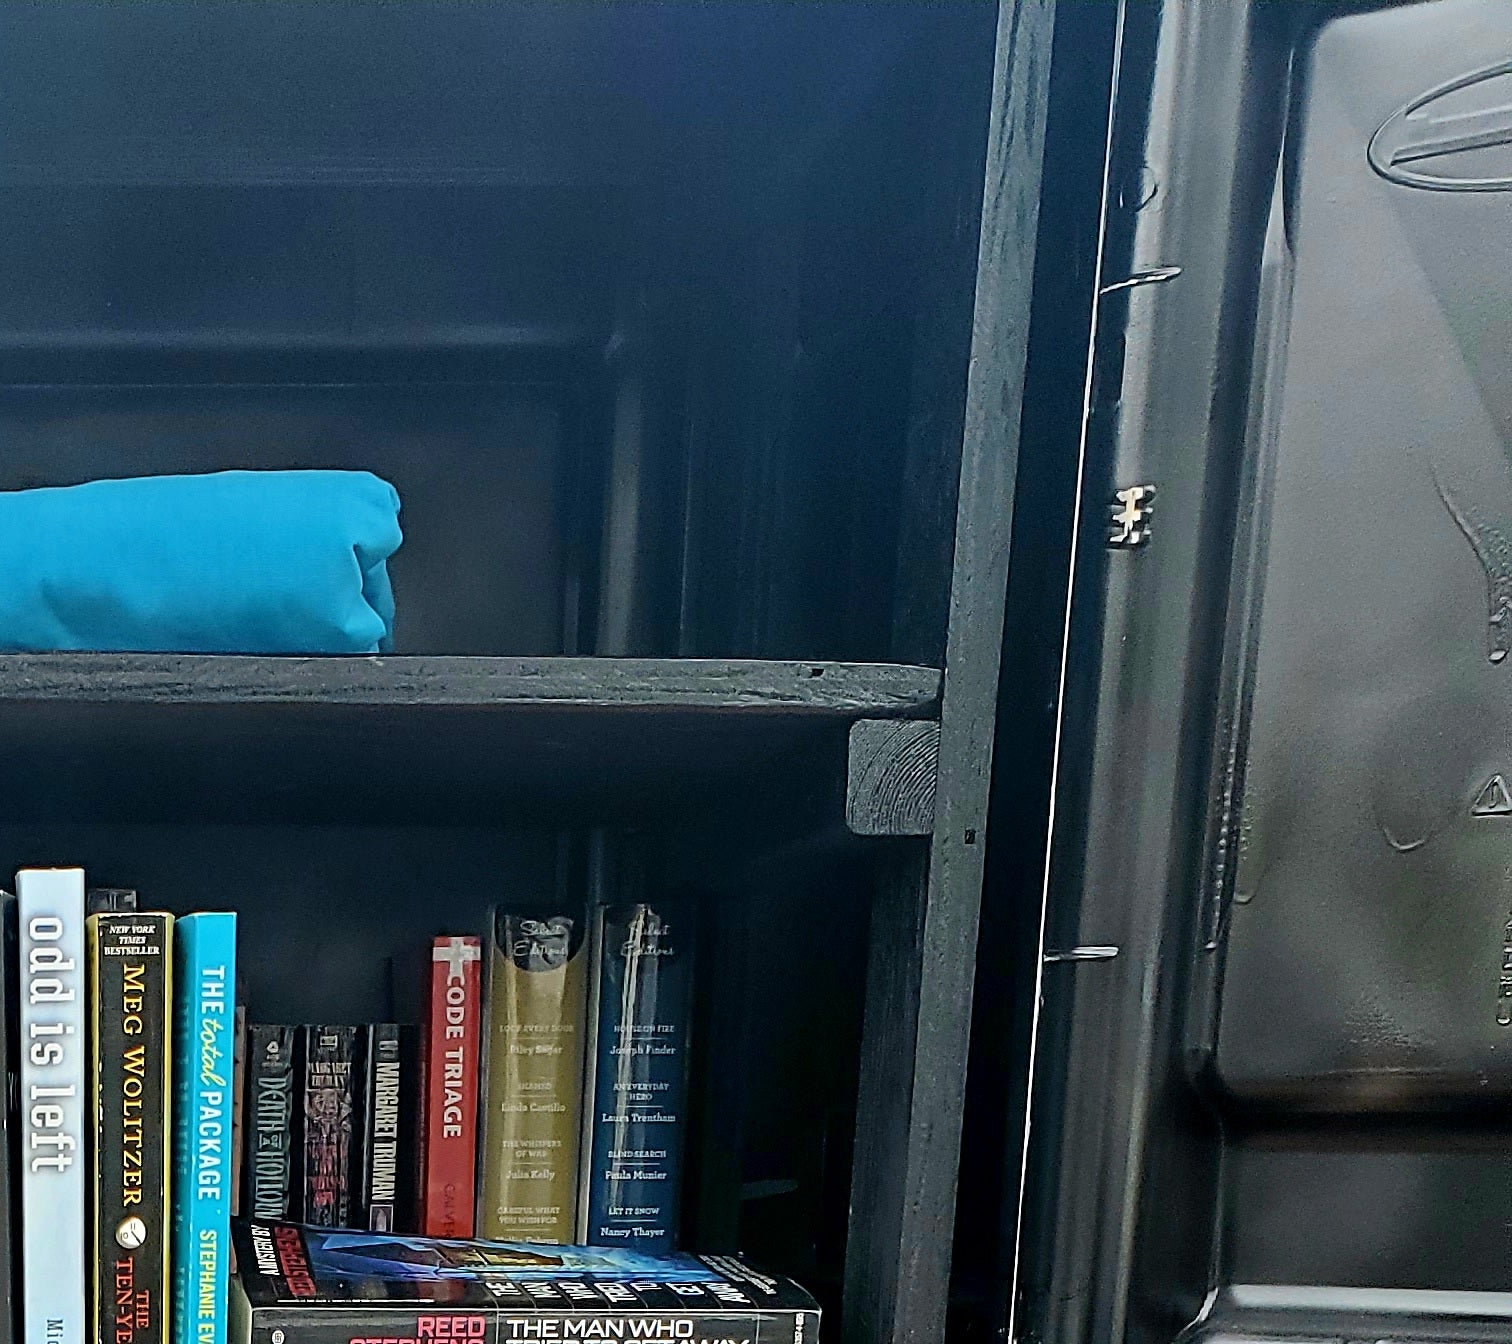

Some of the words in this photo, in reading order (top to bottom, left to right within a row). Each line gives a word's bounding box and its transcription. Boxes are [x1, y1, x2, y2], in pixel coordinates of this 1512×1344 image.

[27, 916, 76, 1005] odd
[103, 945, 160, 956] BESTSELLER
[118, 935, 146, 946] TIMES
[123, 962, 145, 1036] MEG
[200, 964, 226, 1015] THE
[445, 975, 466, 1041] CODE
[28, 1022, 75, 1067] is
[199, 1019, 227, 1088] total
[122, 1044, 145, 1207] WOLITZER
[373, 1061, 401, 1138] MARGARET
[442, 1046, 465, 1140] TRIAGE
[29, 1082, 77, 1174] left
[198, 1090, 223, 1200] PACKAGE
[371, 1141, 397, 1201] TRUMAN
[197, 1228, 218, 1320] STEPHANIE
[416, 1314, 487, 1338] REED
[506, 1318, 559, 1338] THE
[562, 1318, 625, 1338] MAN
[628, 1319, 695, 1338] WHO
